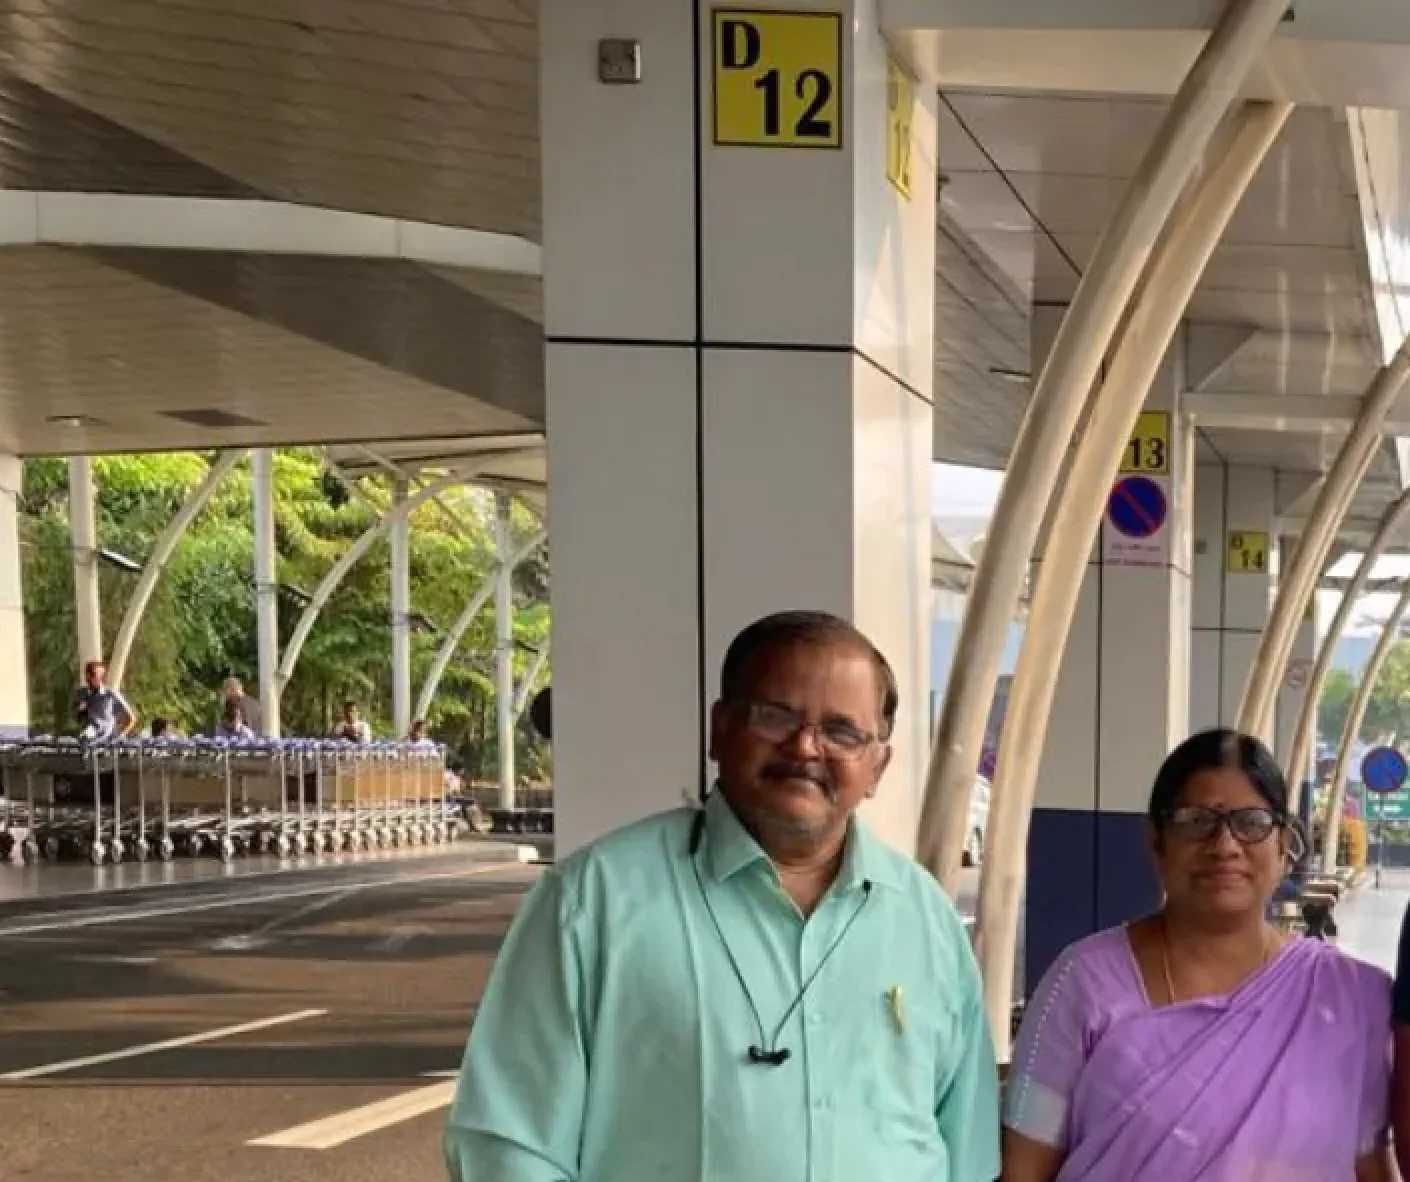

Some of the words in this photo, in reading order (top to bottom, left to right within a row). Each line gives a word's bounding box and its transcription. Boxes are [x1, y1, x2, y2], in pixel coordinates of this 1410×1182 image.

[721, 20, 760, 68] D
[754, 69, 832, 138] 12
[1129, 437, 1165, 469] 13
[1241, 550, 1264, 569] 14
